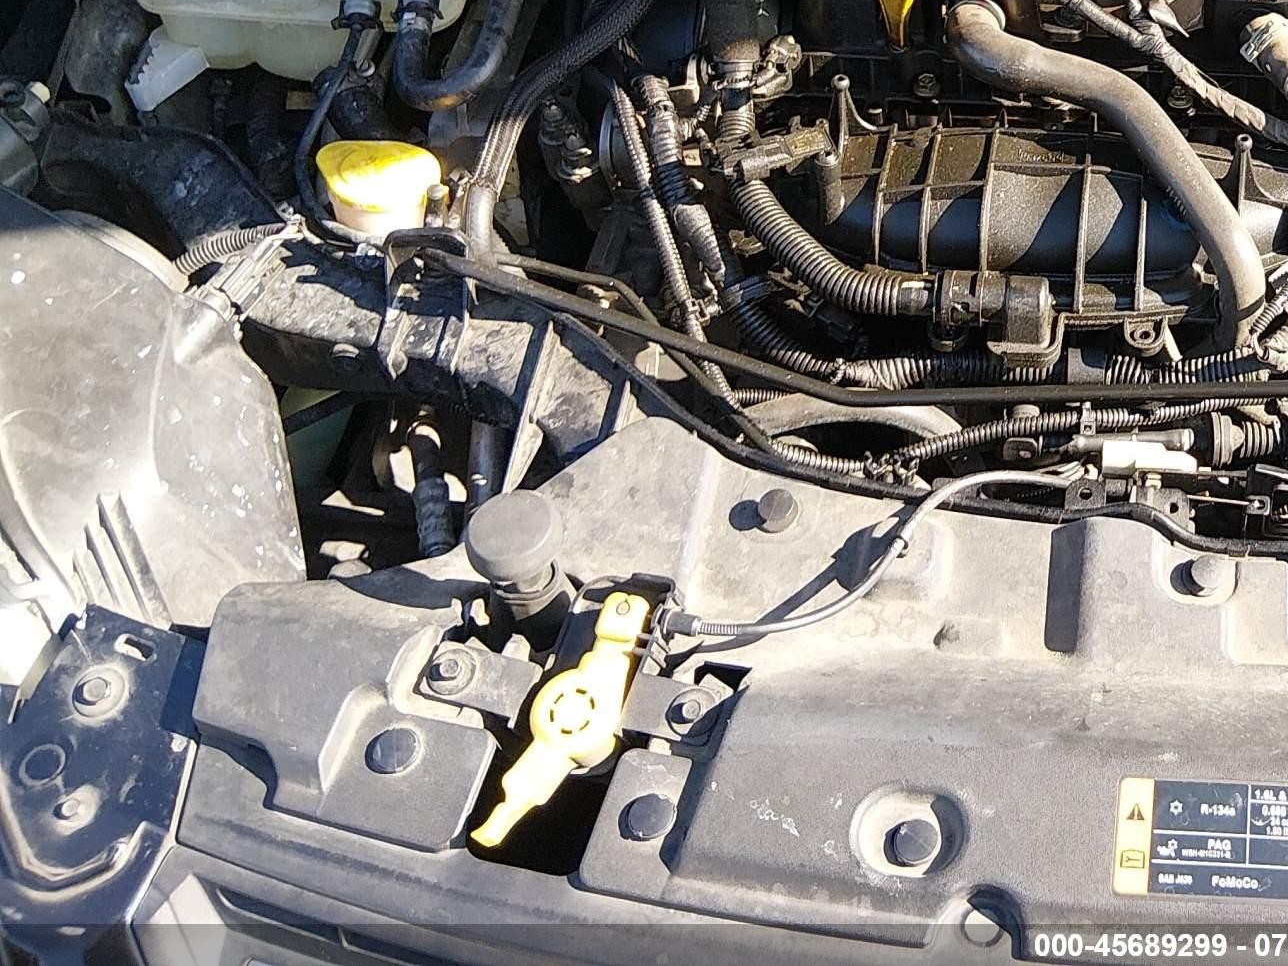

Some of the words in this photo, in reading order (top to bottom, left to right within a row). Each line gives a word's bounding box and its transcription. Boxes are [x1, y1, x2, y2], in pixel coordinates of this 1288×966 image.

[1200, 803, 1236, 817] R-134a
[1207, 838, 1232, 851] PAG
[1211, 875, 1259, 890] FoMoCo
